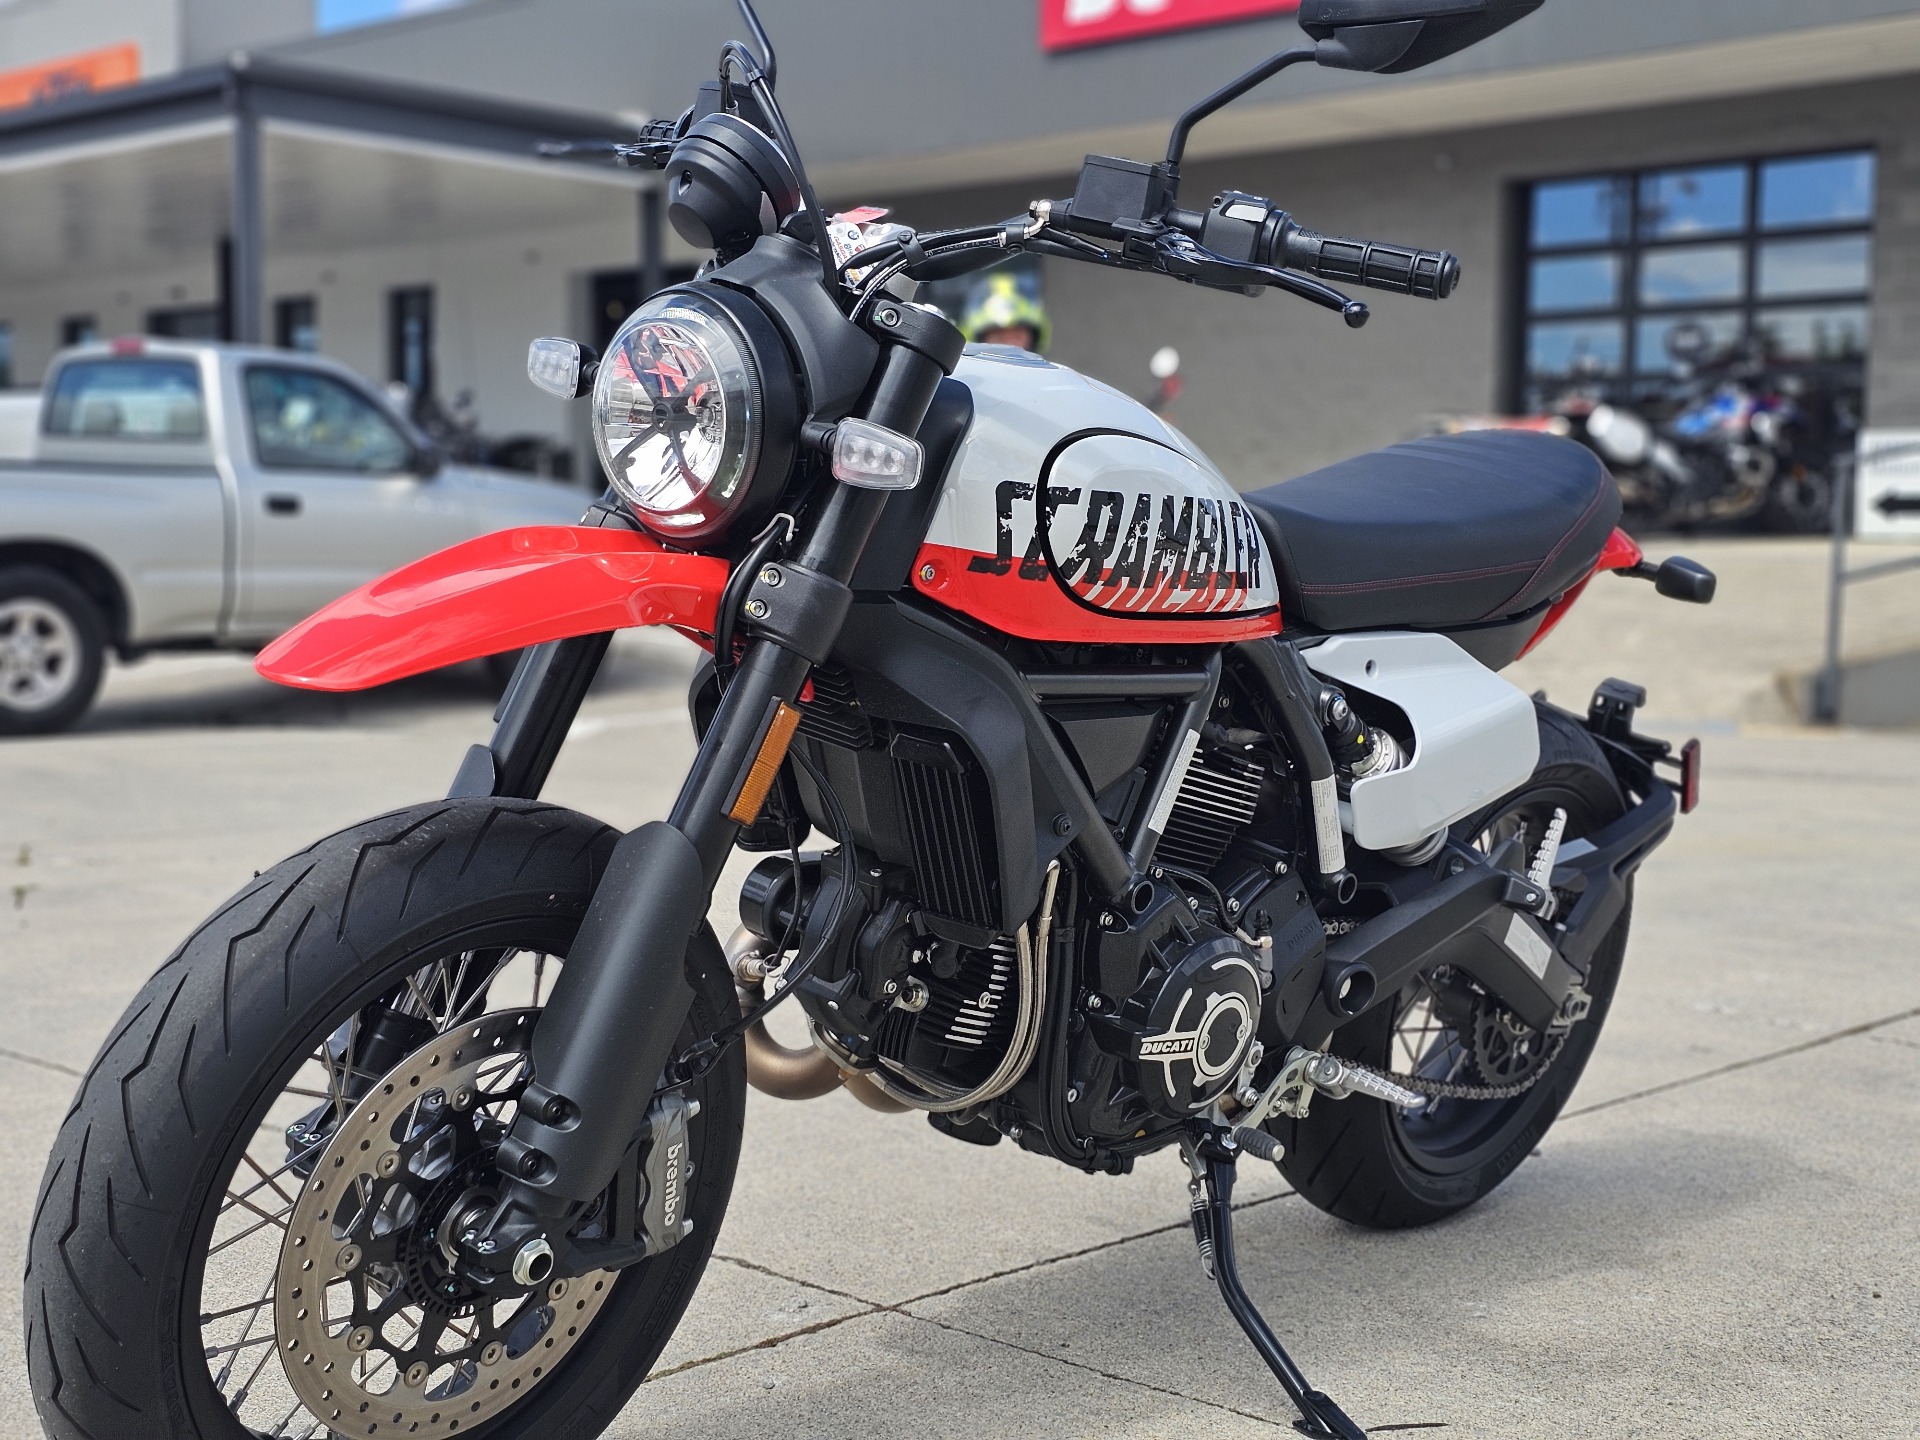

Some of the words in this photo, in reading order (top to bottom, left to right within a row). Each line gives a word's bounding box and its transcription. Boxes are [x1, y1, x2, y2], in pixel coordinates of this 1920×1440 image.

[967, 480, 1261, 590] SCRAMBLER
[1140, 1039, 1194, 1054] DUCATI
[664, 1142, 683, 1227] brembo
